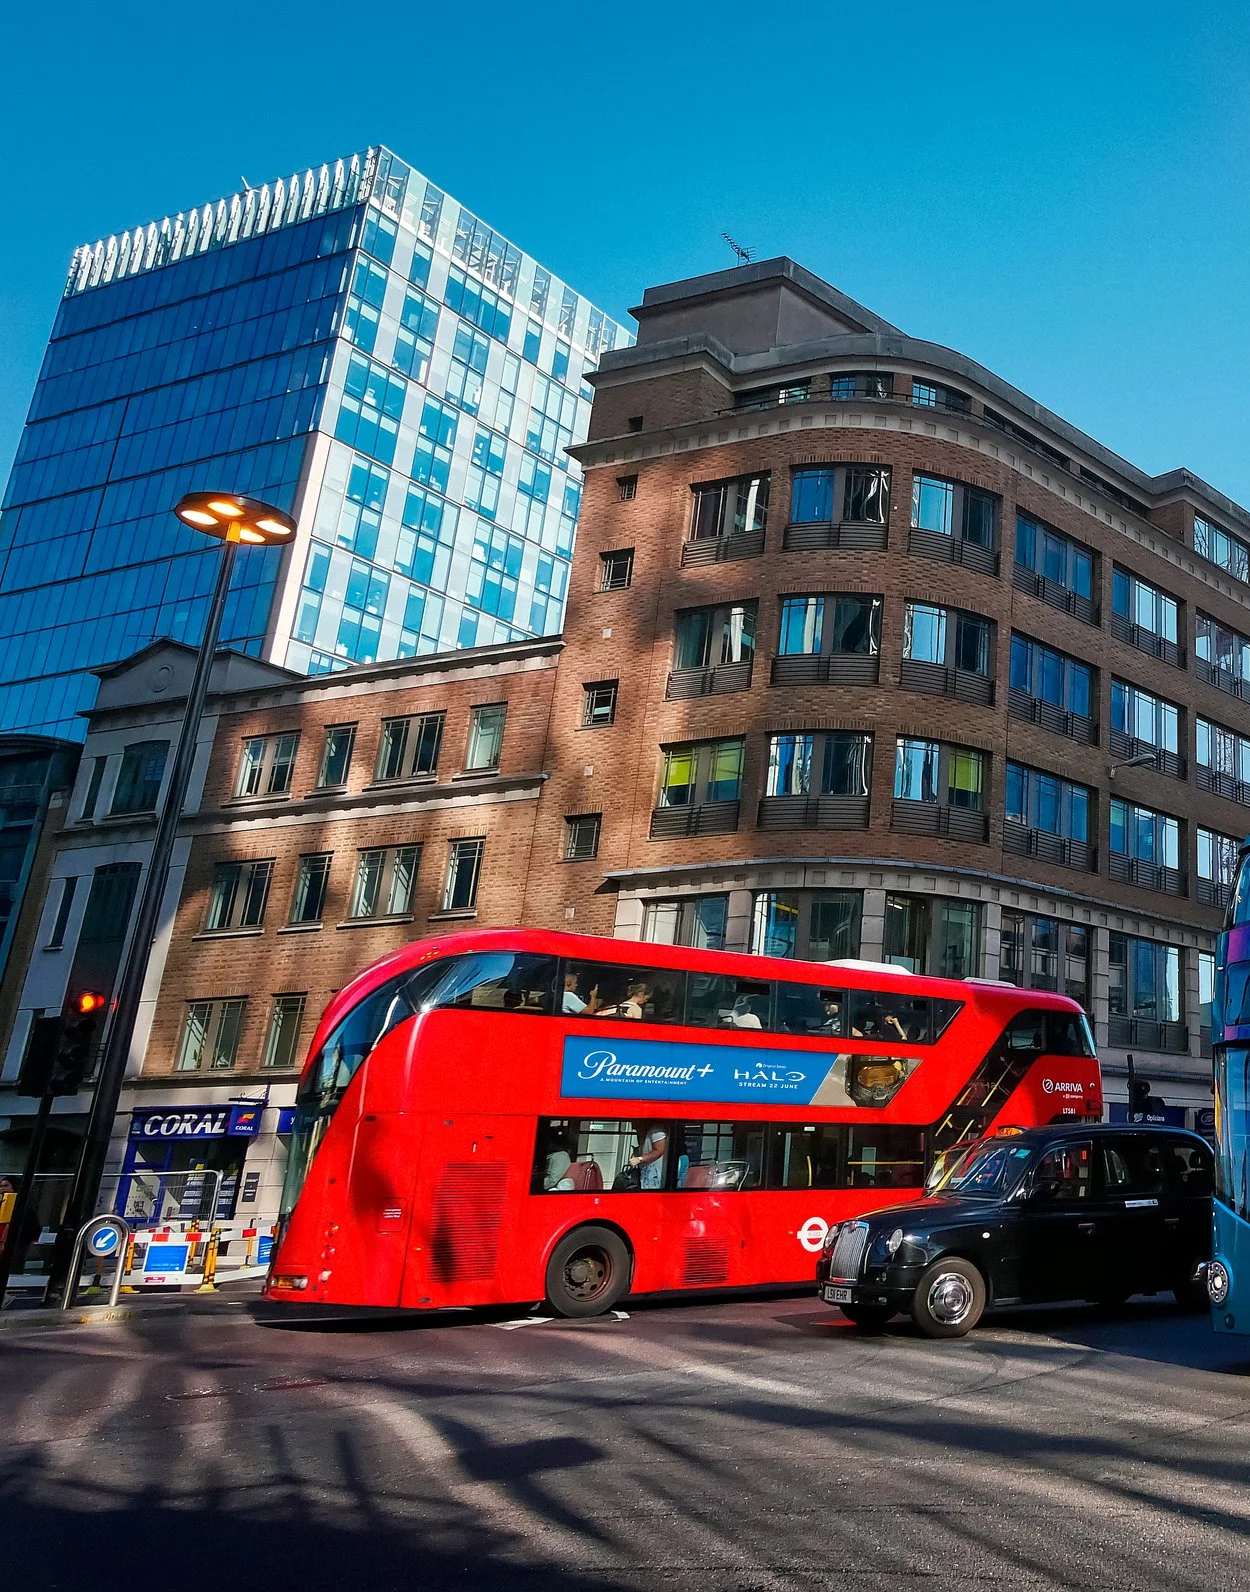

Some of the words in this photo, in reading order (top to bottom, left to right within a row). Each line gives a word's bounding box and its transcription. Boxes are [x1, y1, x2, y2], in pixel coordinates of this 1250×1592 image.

[577, 1050, 715, 1081] Paramount+
[733, 1068, 807, 1082] HALO
[1054, 1082, 1084, 1093] ARRIVA
[144, 1112, 227, 1136] CORAL
